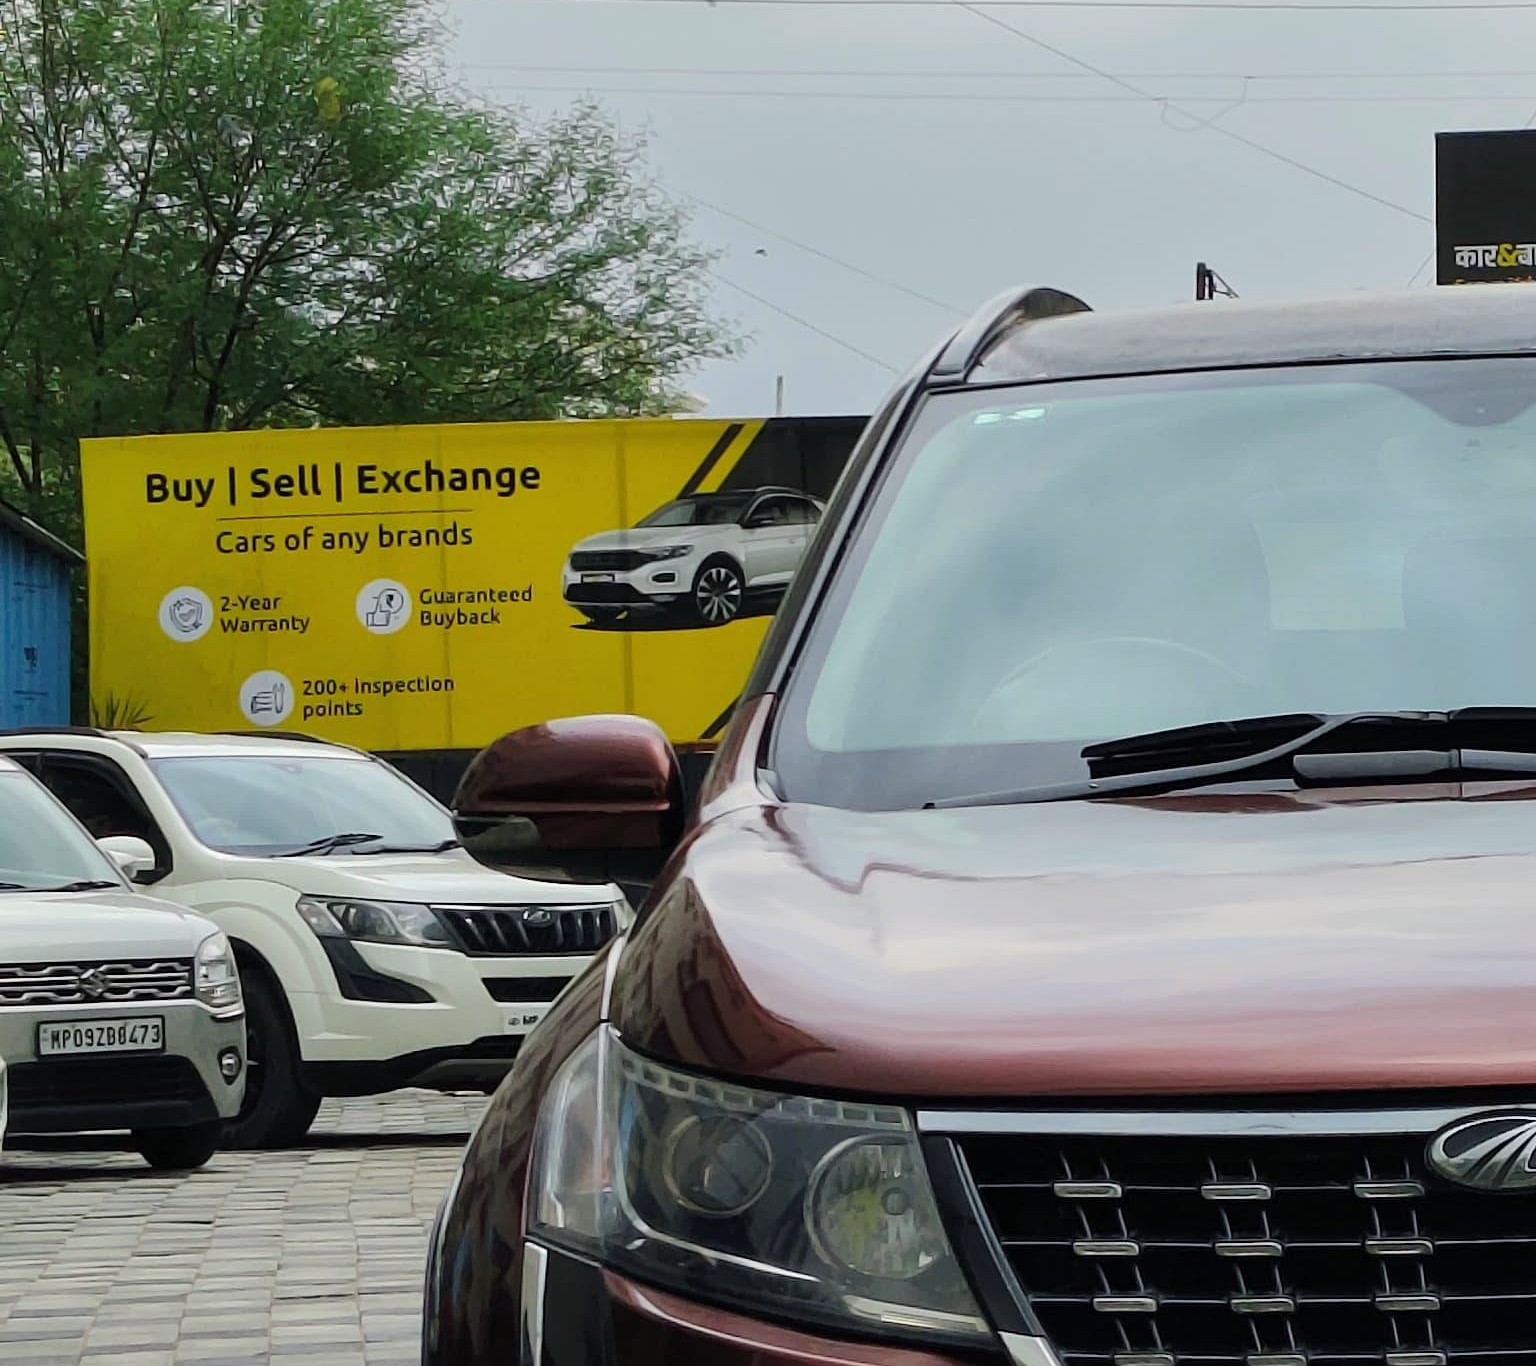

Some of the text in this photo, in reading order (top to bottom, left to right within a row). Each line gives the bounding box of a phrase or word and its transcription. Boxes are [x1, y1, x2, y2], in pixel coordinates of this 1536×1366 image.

[145, 472, 216, 508] Buy
[250, 463, 322, 499] Sell
[356, 459, 542, 497] Exchange
[215, 521, 474, 554] Cars of any brands
[220, 595, 282, 612] 2-Year
[419, 585, 533, 605] Guaranteed
[220, 615, 310, 634] Warranty
[420, 607, 502, 630] Buyback
[302, 678, 348, 696] 200+
[303, 701, 363, 721] points
[50, 1024, 161, 1050] MP09ZB8473
